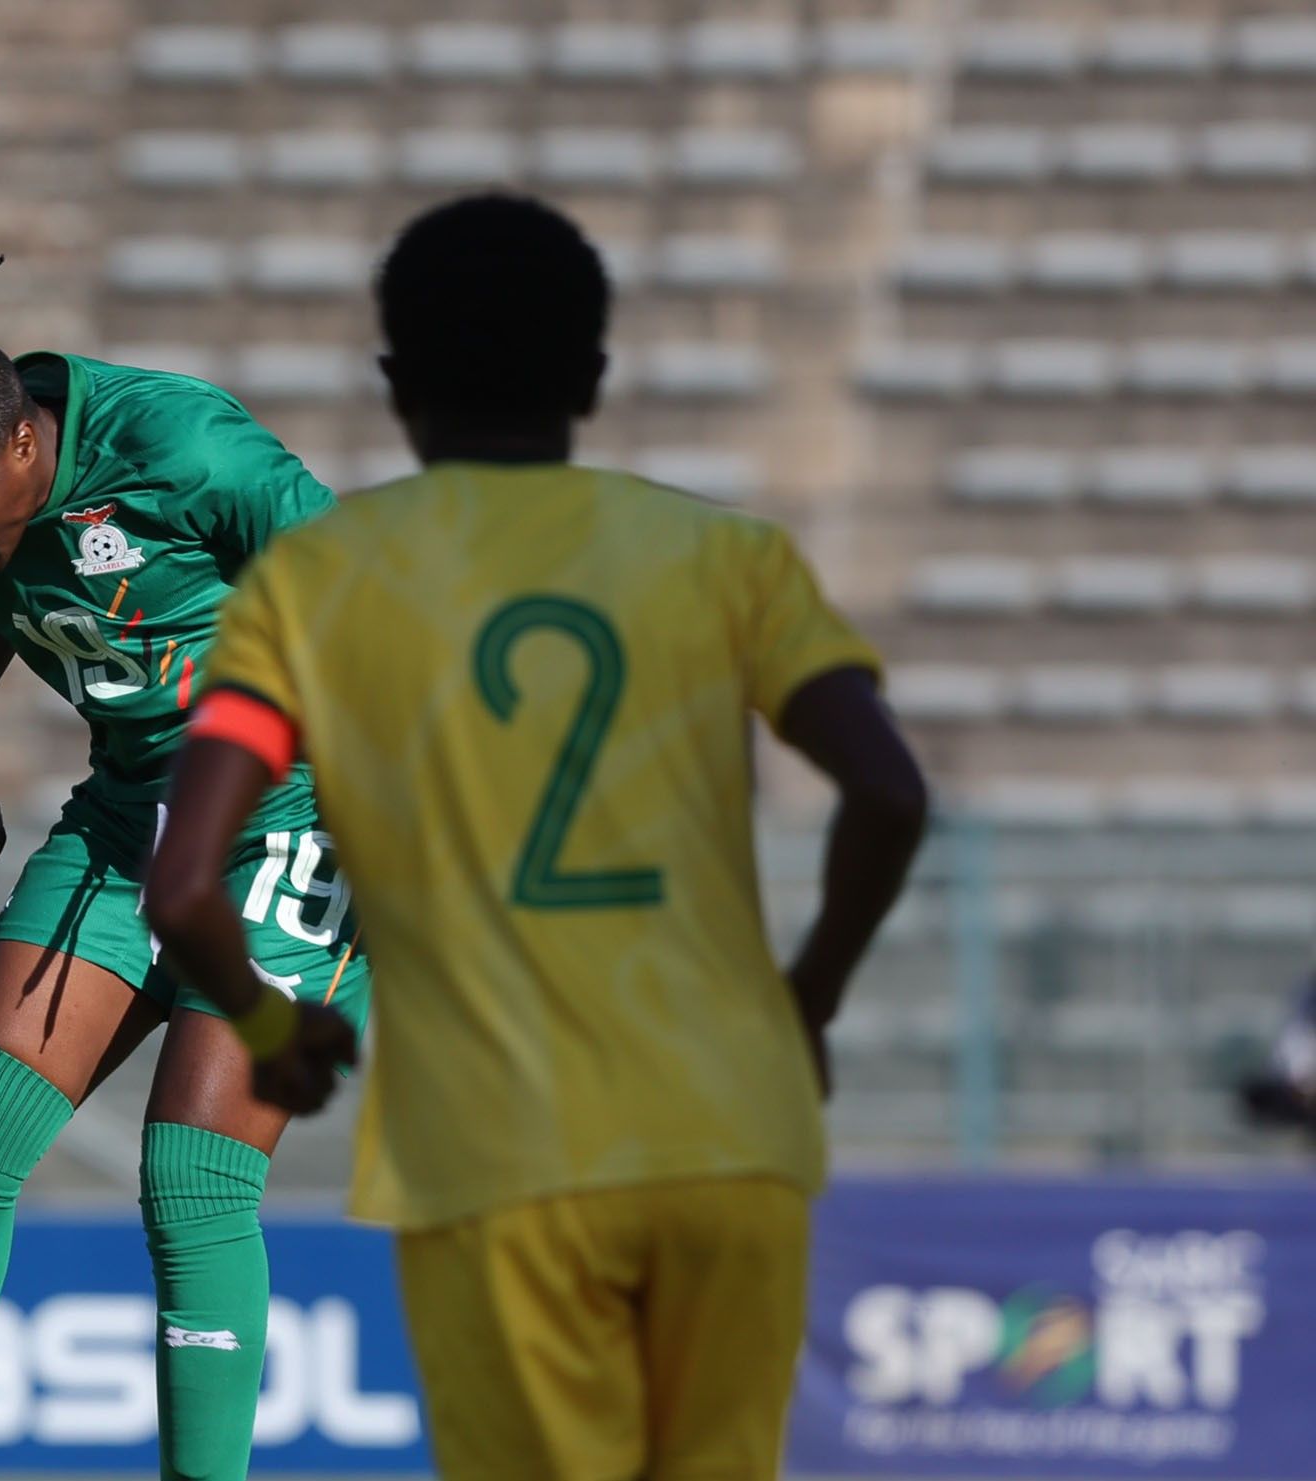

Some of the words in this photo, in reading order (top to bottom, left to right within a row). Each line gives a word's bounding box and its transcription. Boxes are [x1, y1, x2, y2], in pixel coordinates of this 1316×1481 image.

[92, 561, 126, 572] ZAMBIA
[12, 607, 149, 706] 19
[472, 594, 665, 909] 2
[242, 831, 352, 946] 19
